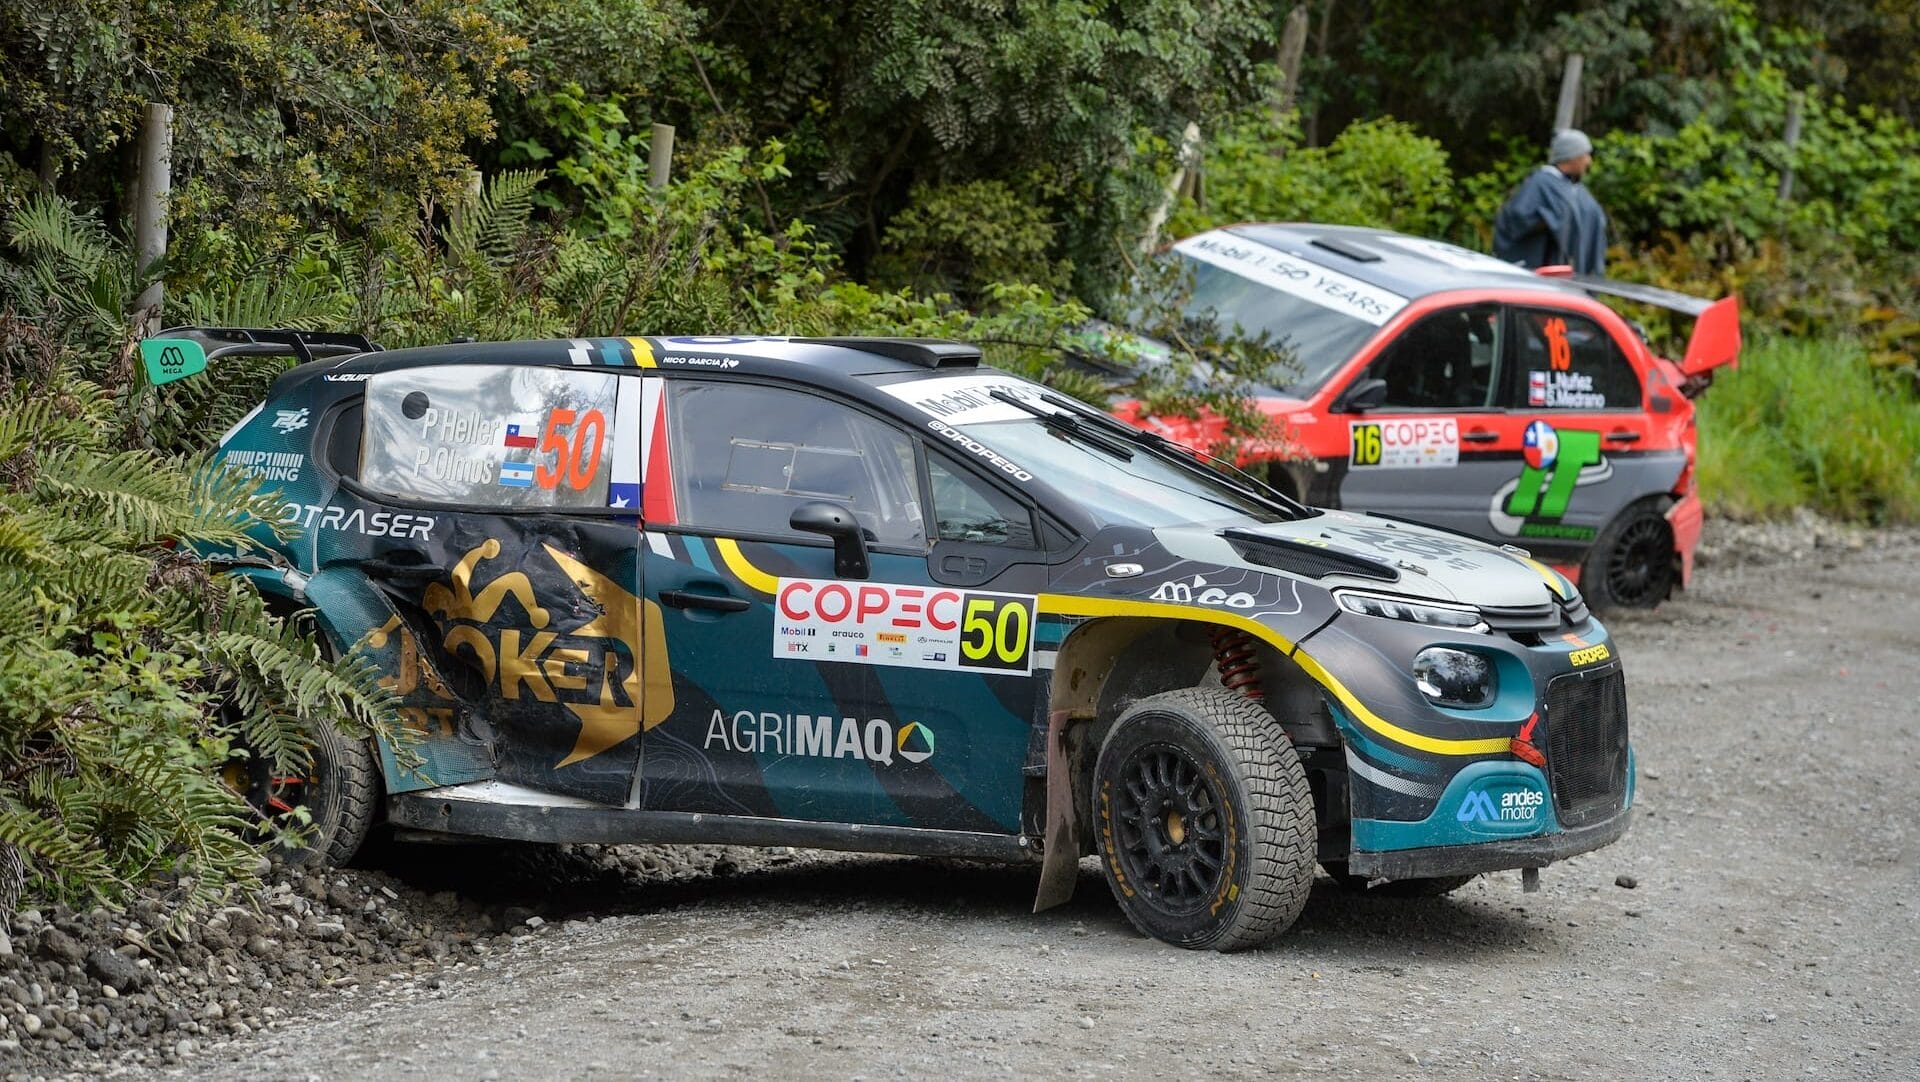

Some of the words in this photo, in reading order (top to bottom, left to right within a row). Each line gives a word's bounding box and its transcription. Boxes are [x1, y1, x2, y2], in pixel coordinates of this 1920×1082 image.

[1272, 263, 1310, 280] 50
[1315, 276, 1389, 316] YEARS
[688, 358, 721, 367] GARCIA
[1543, 318, 1571, 370] 16
[422, 408, 439, 440] P
[440, 408, 502, 446] Heller
[1354, 425, 1381, 464] 16
[1384, 422, 1456, 446] COPEC
[414, 446, 431, 478] P
[433, 447, 494, 484] Olmos
[535, 407, 606, 492] 50
[780, 581, 960, 631] COPEC
[961, 599, 1029, 664] 50
[781, 626, 806, 636] Mobil
[832, 630, 864, 639] arauco
[704, 709, 894, 767] AGRIMAQ
[1502, 788, 1543, 807] andes
[1502, 806, 1537, 820] motor
